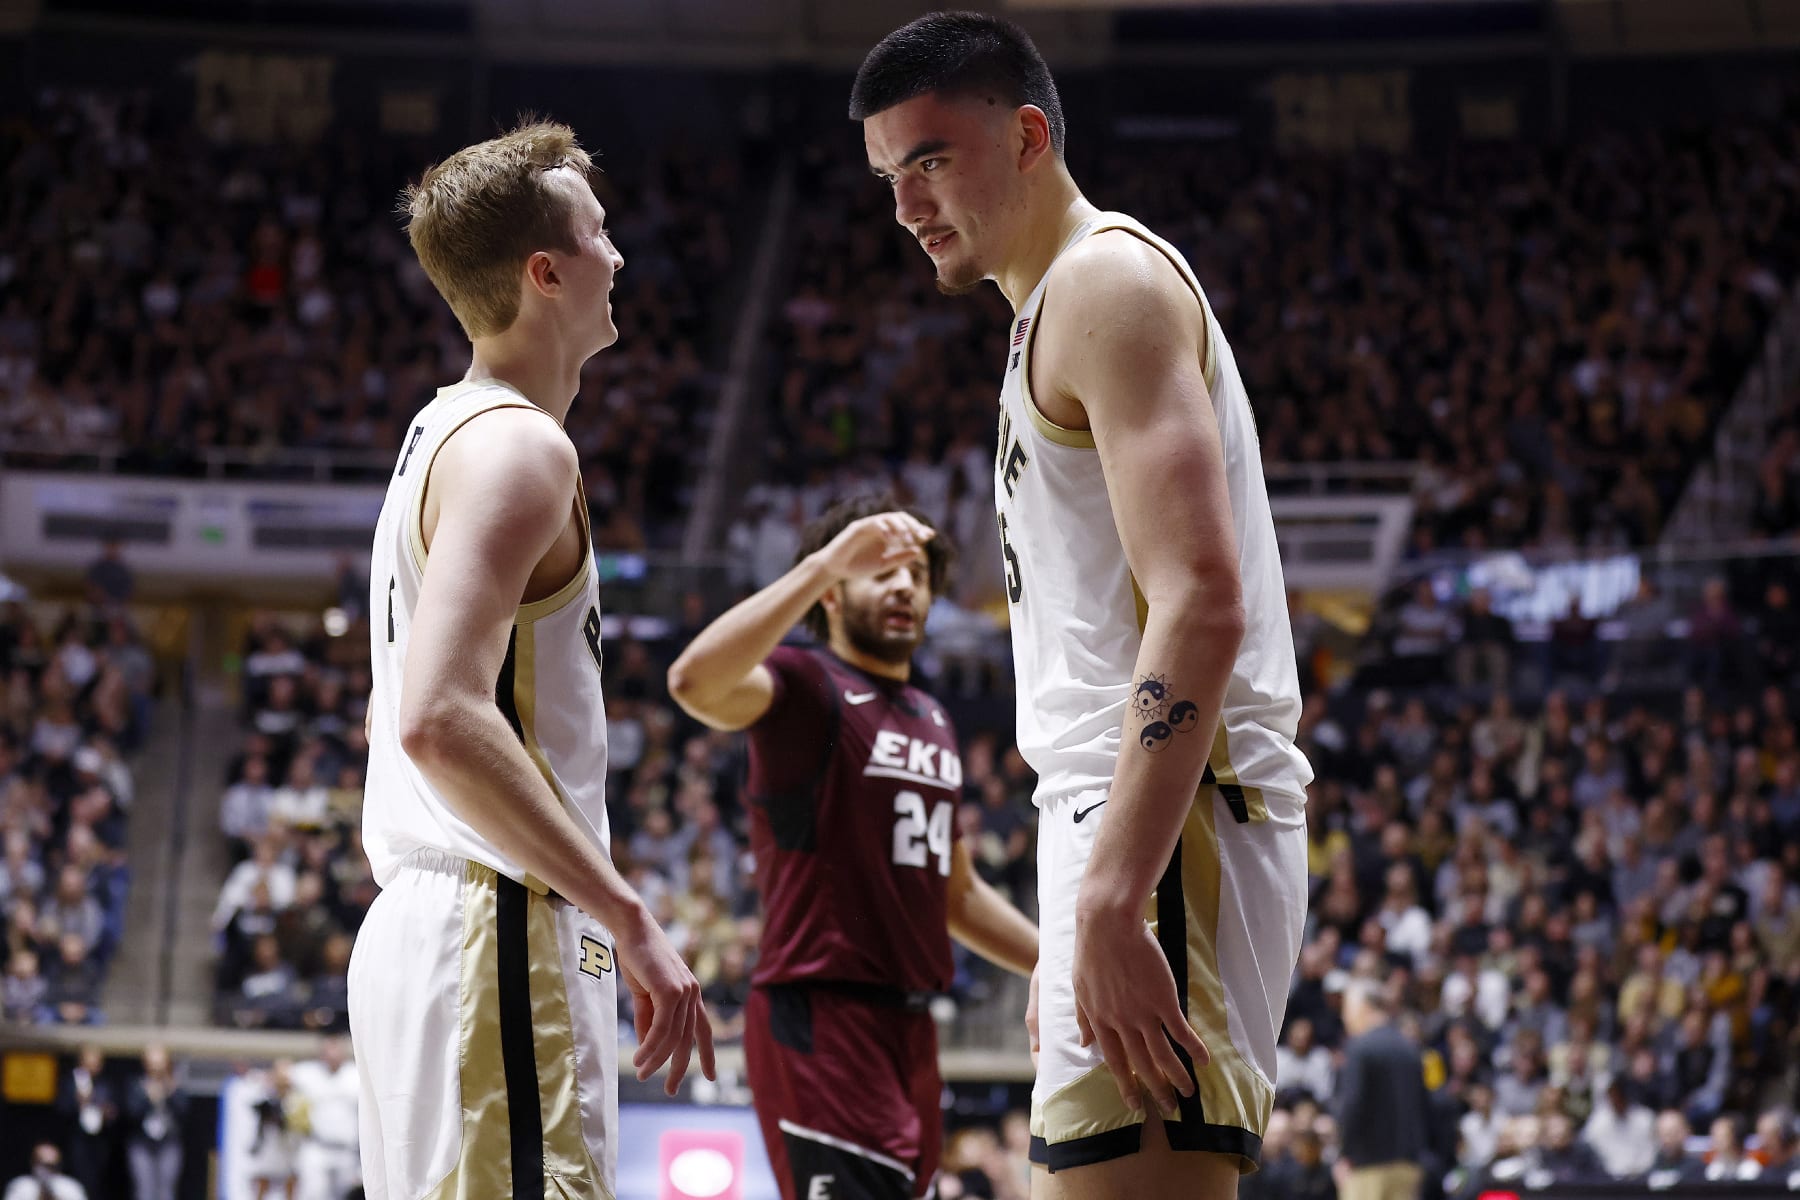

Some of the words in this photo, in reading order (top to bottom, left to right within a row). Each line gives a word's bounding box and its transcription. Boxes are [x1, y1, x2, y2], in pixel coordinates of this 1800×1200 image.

[870, 729, 963, 788] EKU
[892, 790, 954, 876] 24
[579, 934, 612, 980] P
